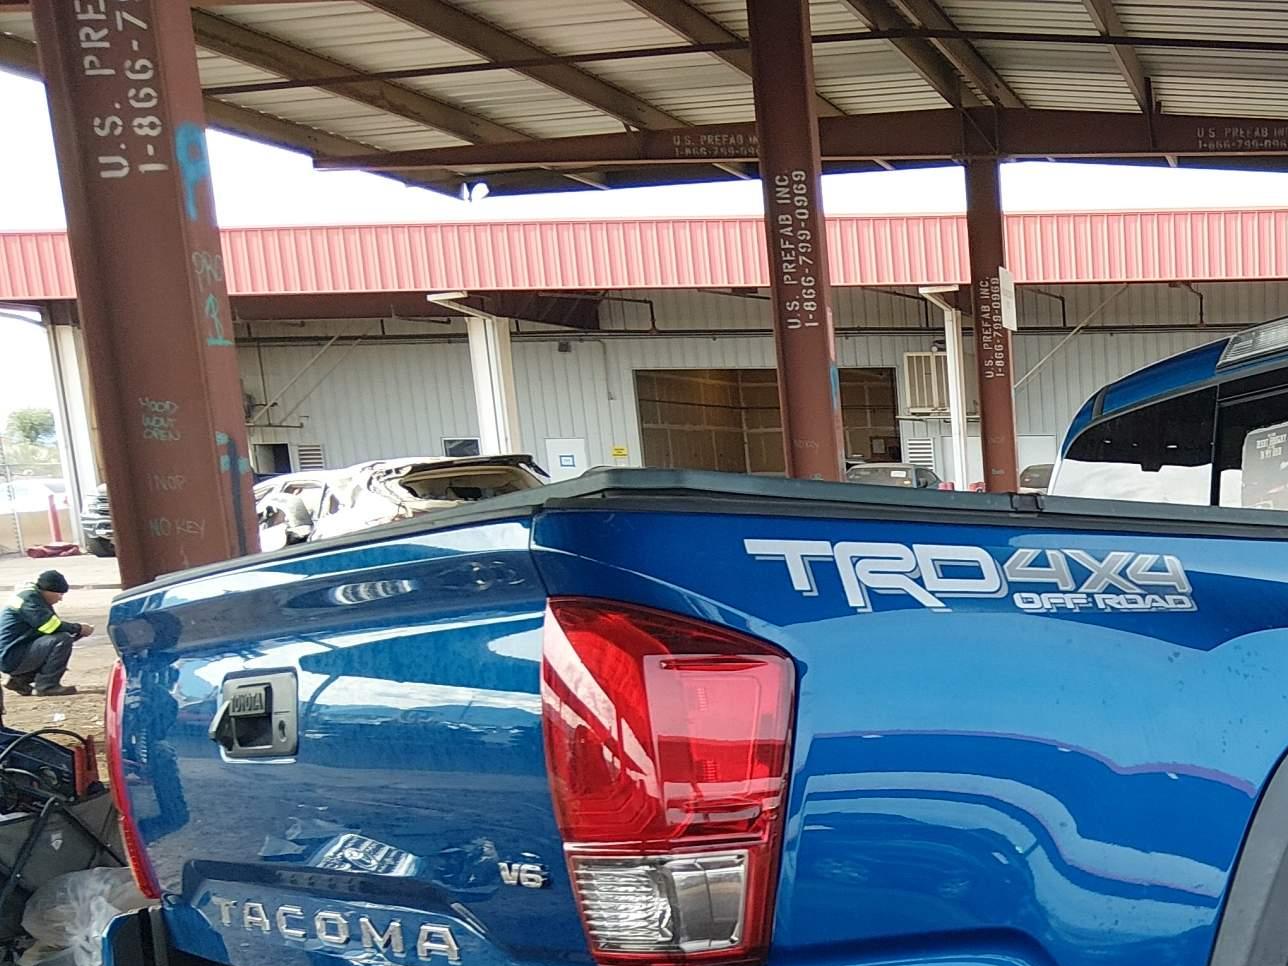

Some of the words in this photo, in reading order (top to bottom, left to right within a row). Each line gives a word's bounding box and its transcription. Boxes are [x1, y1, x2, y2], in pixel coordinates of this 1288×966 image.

[115, 0, 169, 173] 1-866-7
[93, 102, 130, 178] U.S.
[778, 214, 798, 284] PREFAB
[792, 170, 819, 327] 1-866-799-0969
[786, 295, 801, 329] U.S.
[980, 276, 990, 299] INC.
[981, 305, 992, 350] PREFAB
[990, 277, 1005, 377] 1-866-799-0969
[985, 356, 994, 378] U.S.
[744, 538, 1003, 612] TRD
[1002, 548, 1192, 595] 4X4
[499, 861, 546, 888] V6
[211, 897, 463, 964] TACOMA
